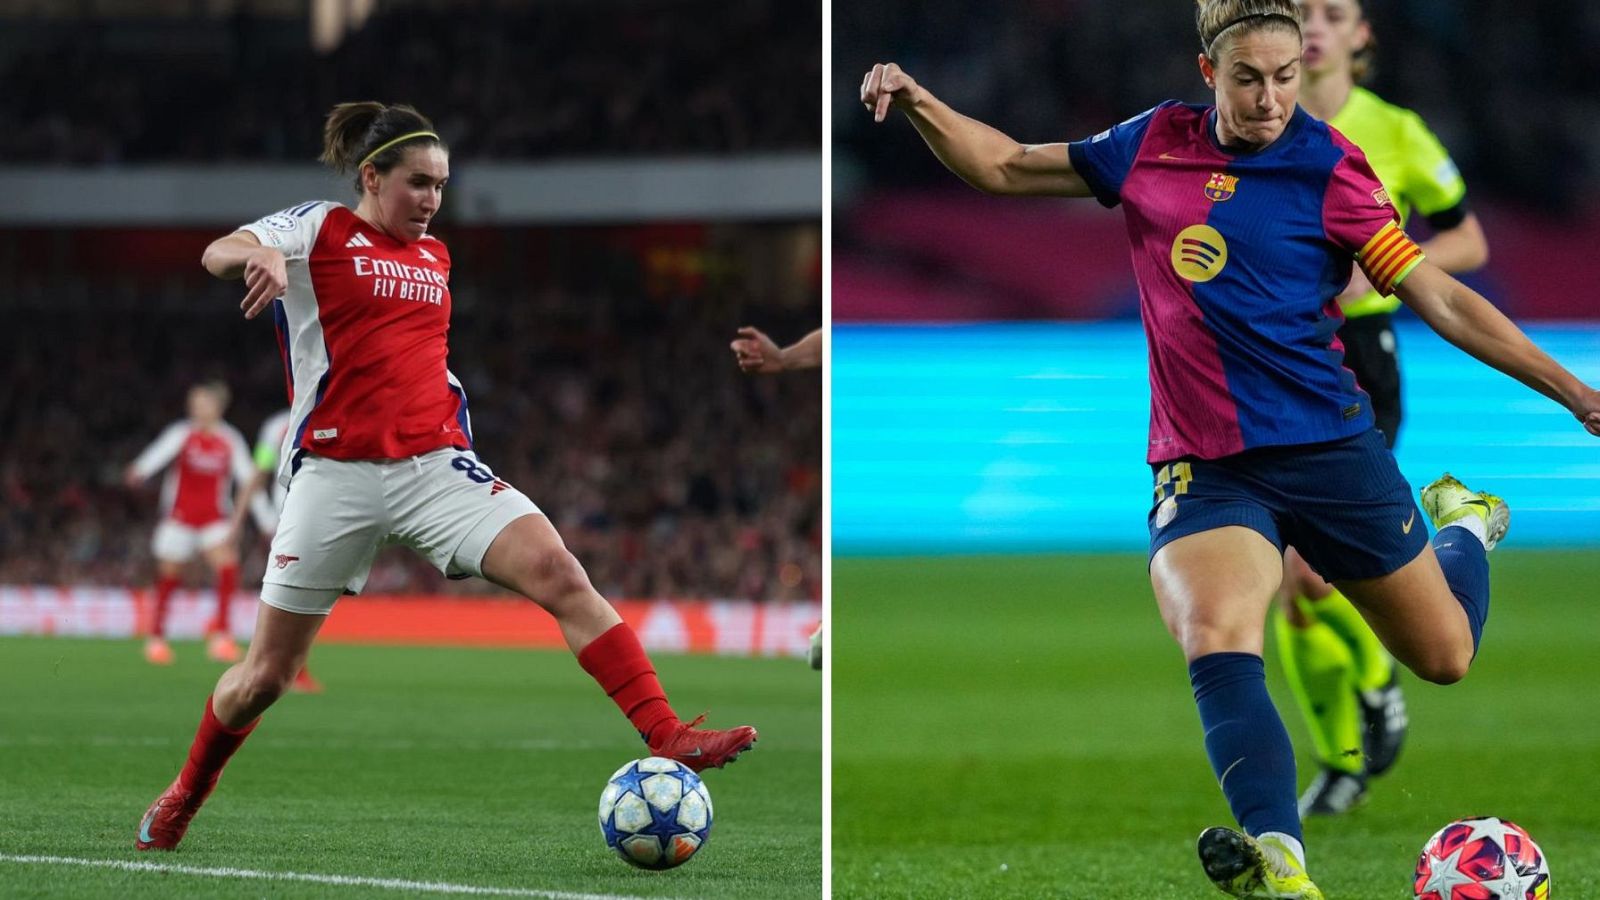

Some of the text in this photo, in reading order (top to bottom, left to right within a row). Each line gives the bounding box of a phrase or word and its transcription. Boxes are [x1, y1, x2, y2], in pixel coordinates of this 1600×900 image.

[373, 278, 443, 305] FLY BETTER
[451, 456, 495, 484] 8
